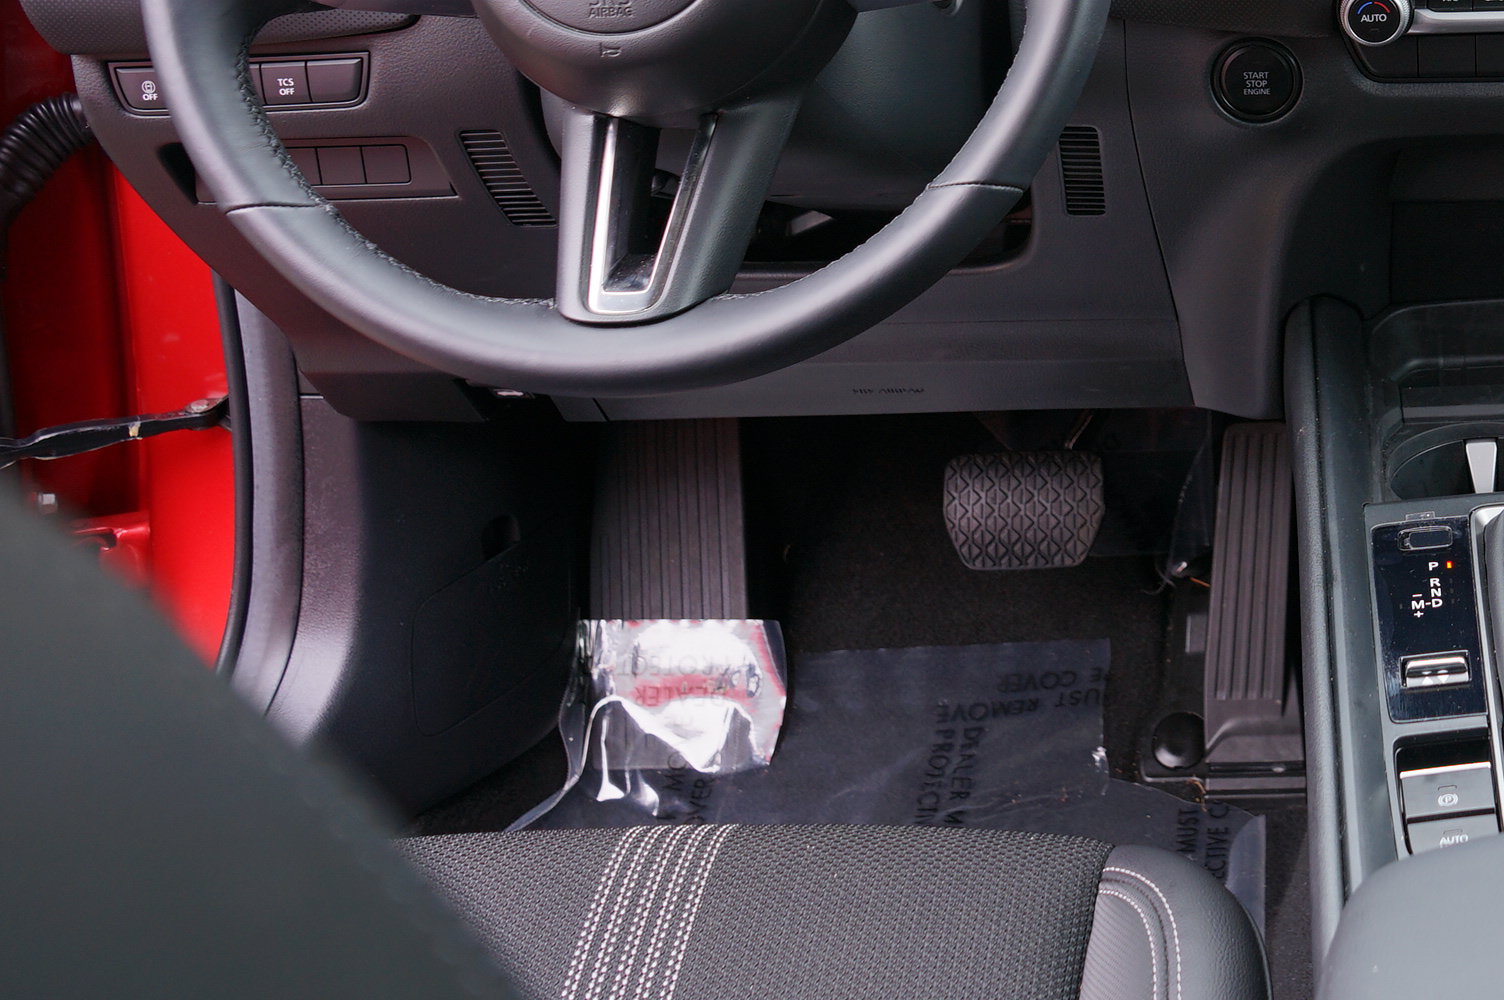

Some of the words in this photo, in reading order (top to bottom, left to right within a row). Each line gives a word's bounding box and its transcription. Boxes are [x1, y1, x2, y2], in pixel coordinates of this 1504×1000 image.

[588, 6, 633, 19] AIRBAG
[1360, 14, 1387, 23] AUTO
[1243, 71, 1269, 80] START
[277, 78, 295, 87] TCS
[1245, 80, 1268, 88] STOP
[279, 87, 295, 96] OFF
[1243, 88, 1271, 96] ENGINE
[142, 93, 158, 101] OFF
[1428, 561, 1439, 571] P
[1430, 577, 1441, 588] R
[1430, 587, 1442, 598] N
[1176, 808, 1200, 853] MUST
